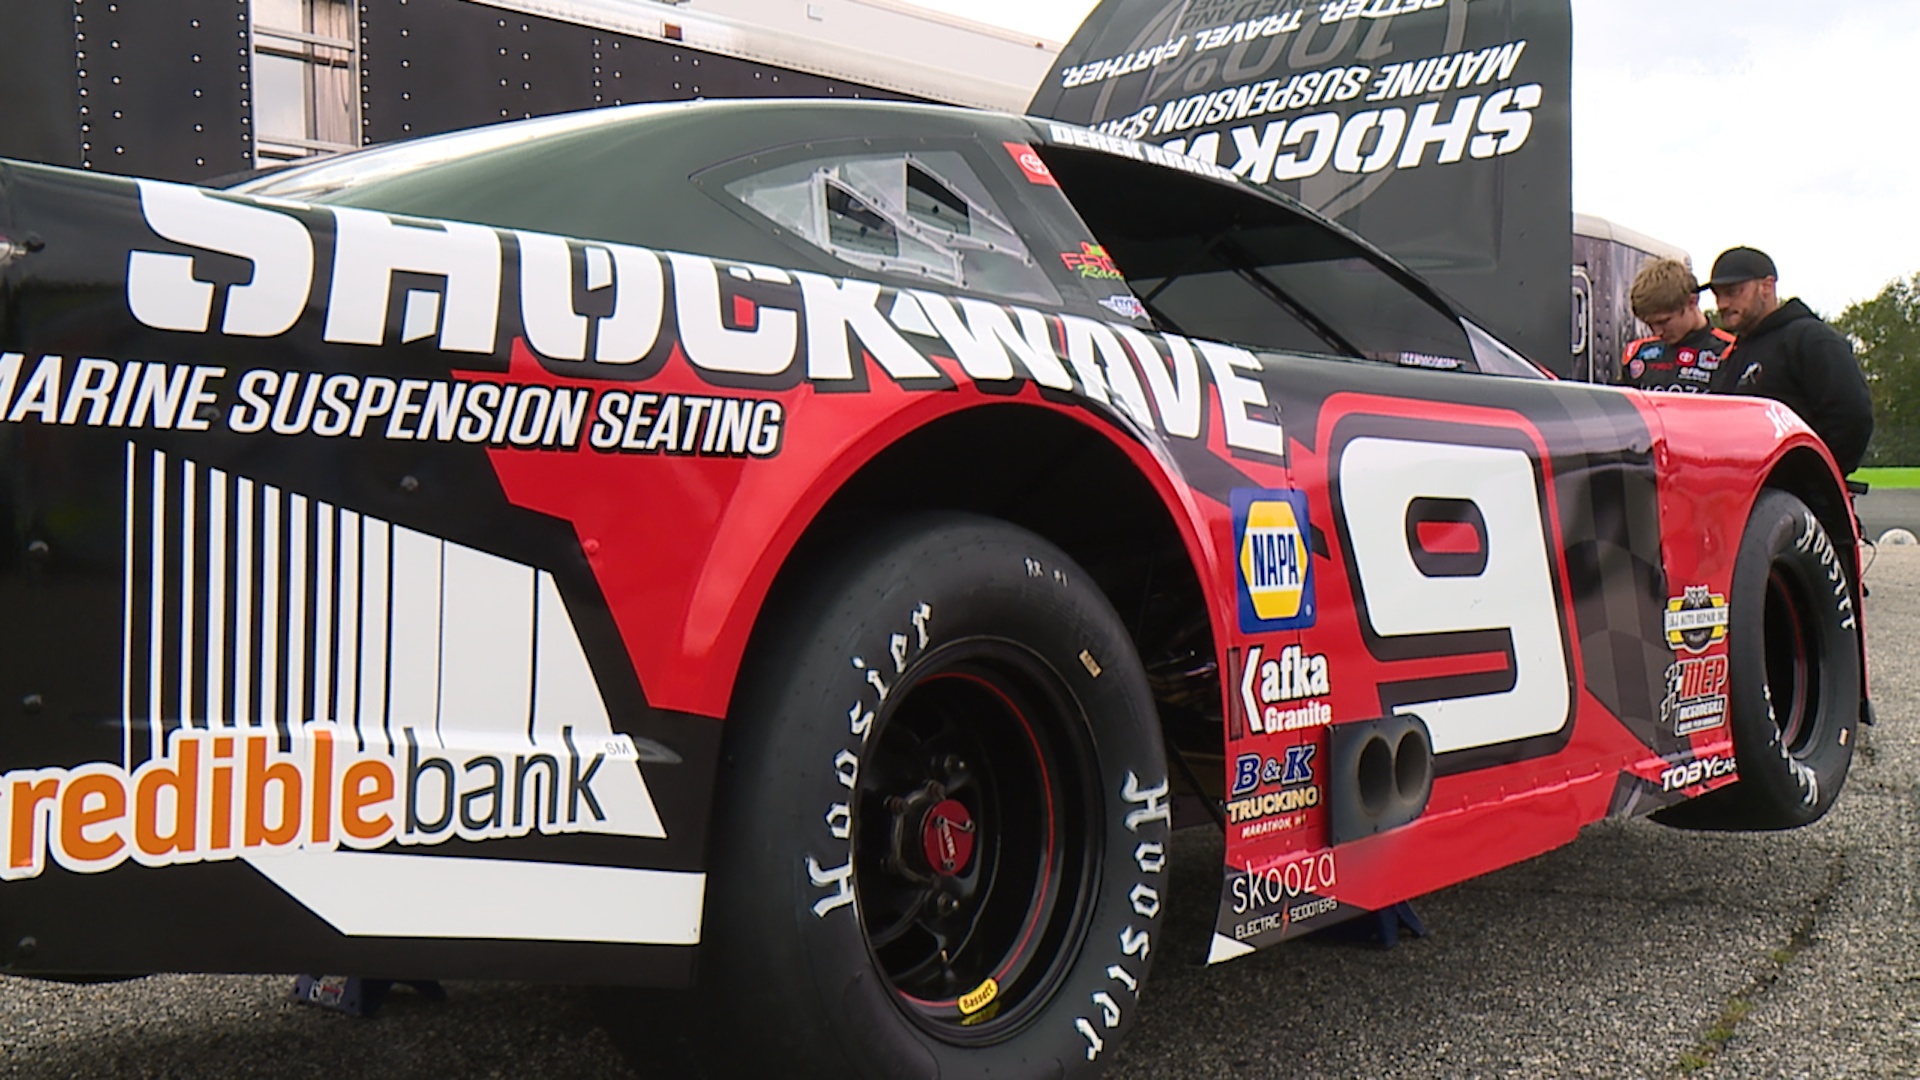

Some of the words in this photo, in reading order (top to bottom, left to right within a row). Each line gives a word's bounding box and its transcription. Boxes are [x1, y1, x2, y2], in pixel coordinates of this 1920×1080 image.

[1194, 9, 1303, 52] TRAVEL
[1062, 35, 1188, 89] FARTHER.
[1366, 40, 1527, 101] MARINE
[1152, 65, 1375, 136] SUSPENSION
[1050, 124, 1145, 161] DEREK
[127, 177, 1283, 456] SHOCKWAVE
[228, 368, 588, 447] SUSPENSION
[590, 392, 783, 455] SEATING
[1251, 531, 1300, 588] NAPA
[1339, 436, 1571, 754] 9
[1228, 644, 1330, 738] Kafka
[1264, 701, 1332, 735] Granite
[804, 602, 932, 921] Hoosier
[0, 726, 607, 869] rediblebank
[1226, 785, 1319, 824] TRUCKING
[1232, 852, 1336, 914] skooza
[1289, 896, 1338, 923] SCOOTERS
[1076, 770, 1173, 1061] Hoosier
[961, 982, 995, 1010] Bassett
